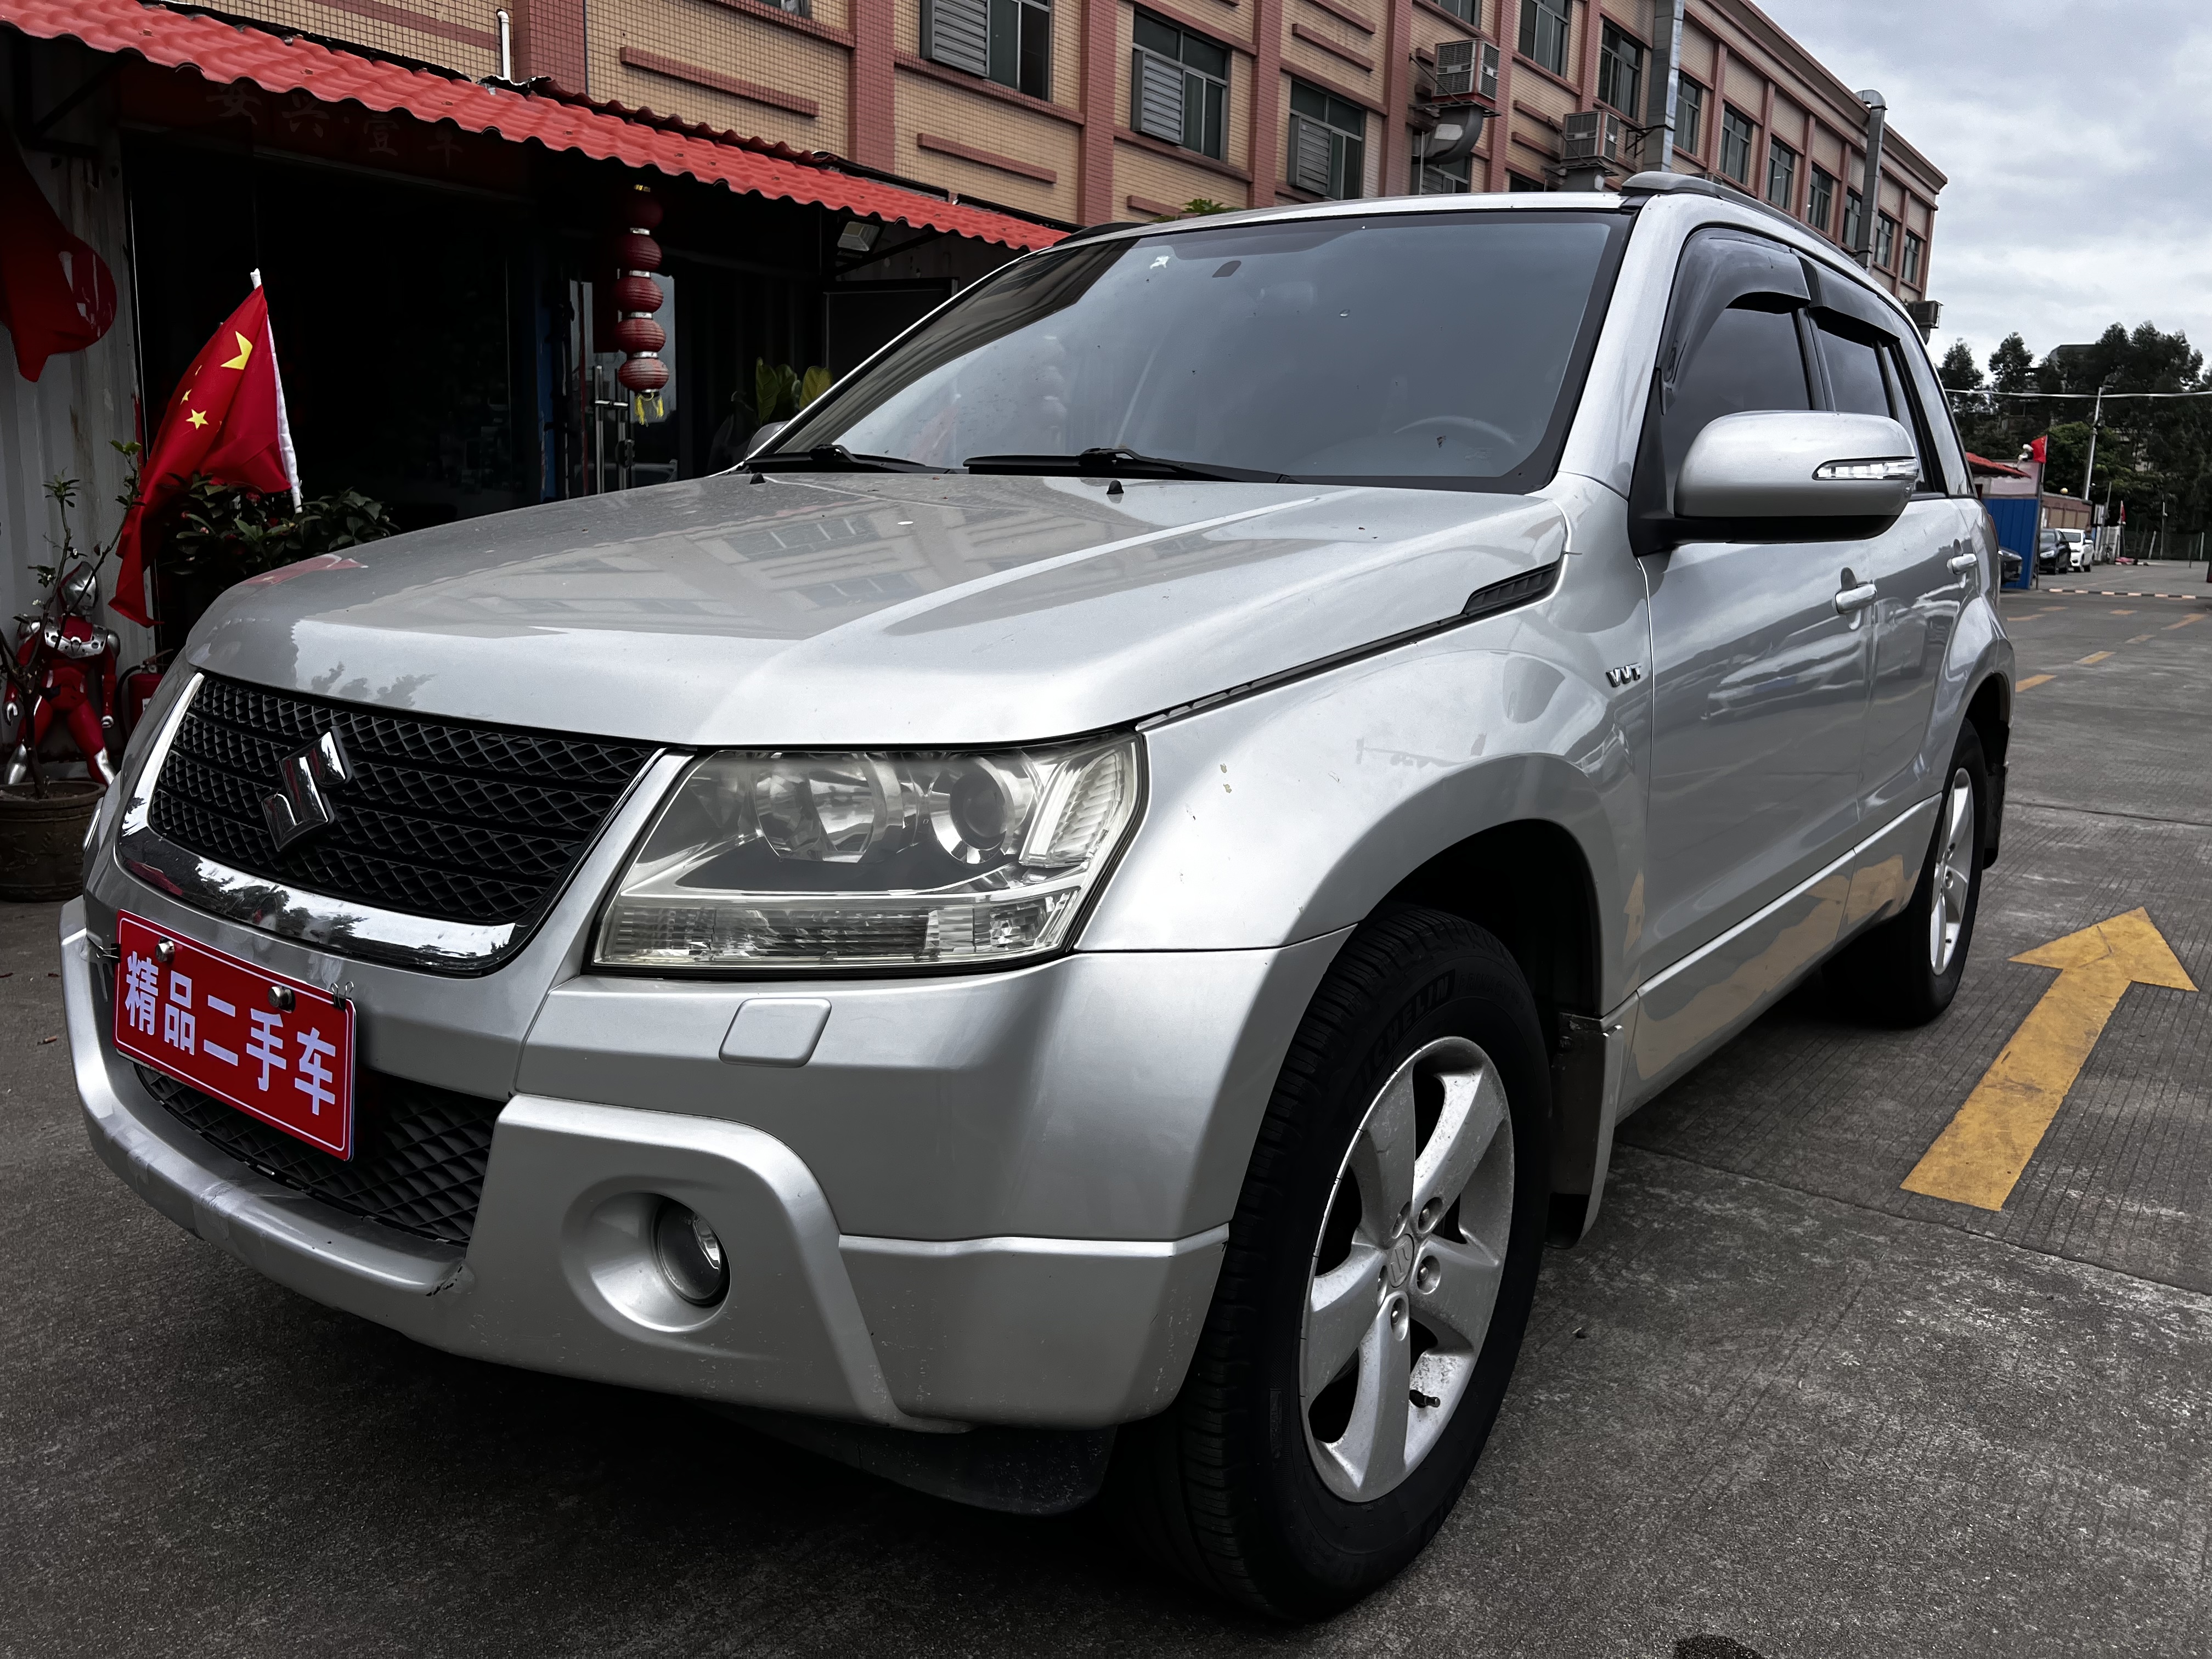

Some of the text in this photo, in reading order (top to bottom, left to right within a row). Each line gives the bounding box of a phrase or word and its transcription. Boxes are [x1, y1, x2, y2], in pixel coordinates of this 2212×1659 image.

[1605, 662, 1641, 687] VVT
[125, 951, 336, 1115] 精品二手车
